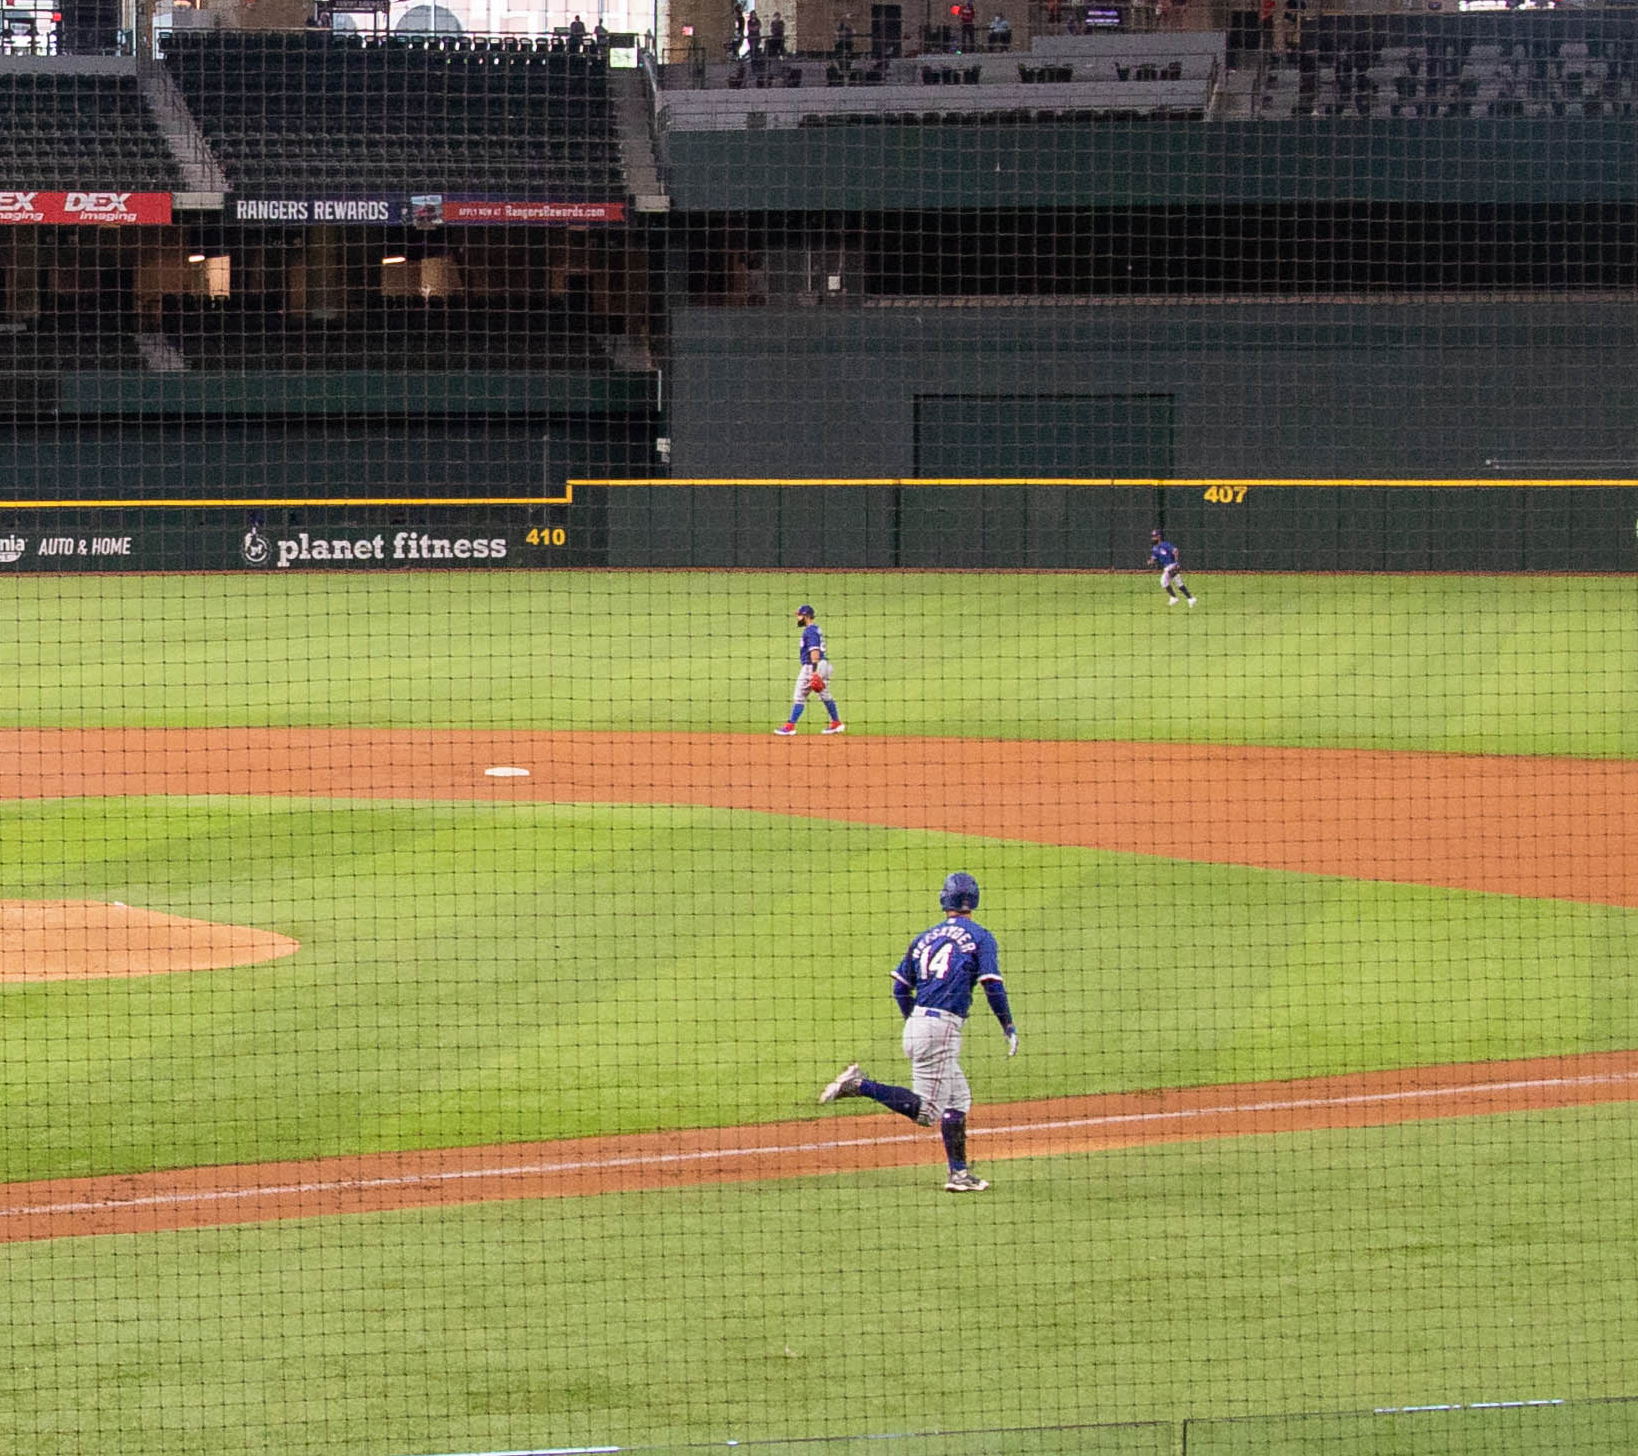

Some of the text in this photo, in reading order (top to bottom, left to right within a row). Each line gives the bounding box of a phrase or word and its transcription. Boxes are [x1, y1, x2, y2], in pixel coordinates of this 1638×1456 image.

[64, 191, 132, 211] DEX
[237, 200, 390, 220] RANGERS REWARDS
[79, 210, 137, 222] imaging
[1203, 486, 1248, 504] 407
[526, 527, 566, 546] 410
[38, 537, 132, 556] AUTO & HOME
[277, 530, 507, 567] planet fitness
[919, 943, 953, 979] 14
